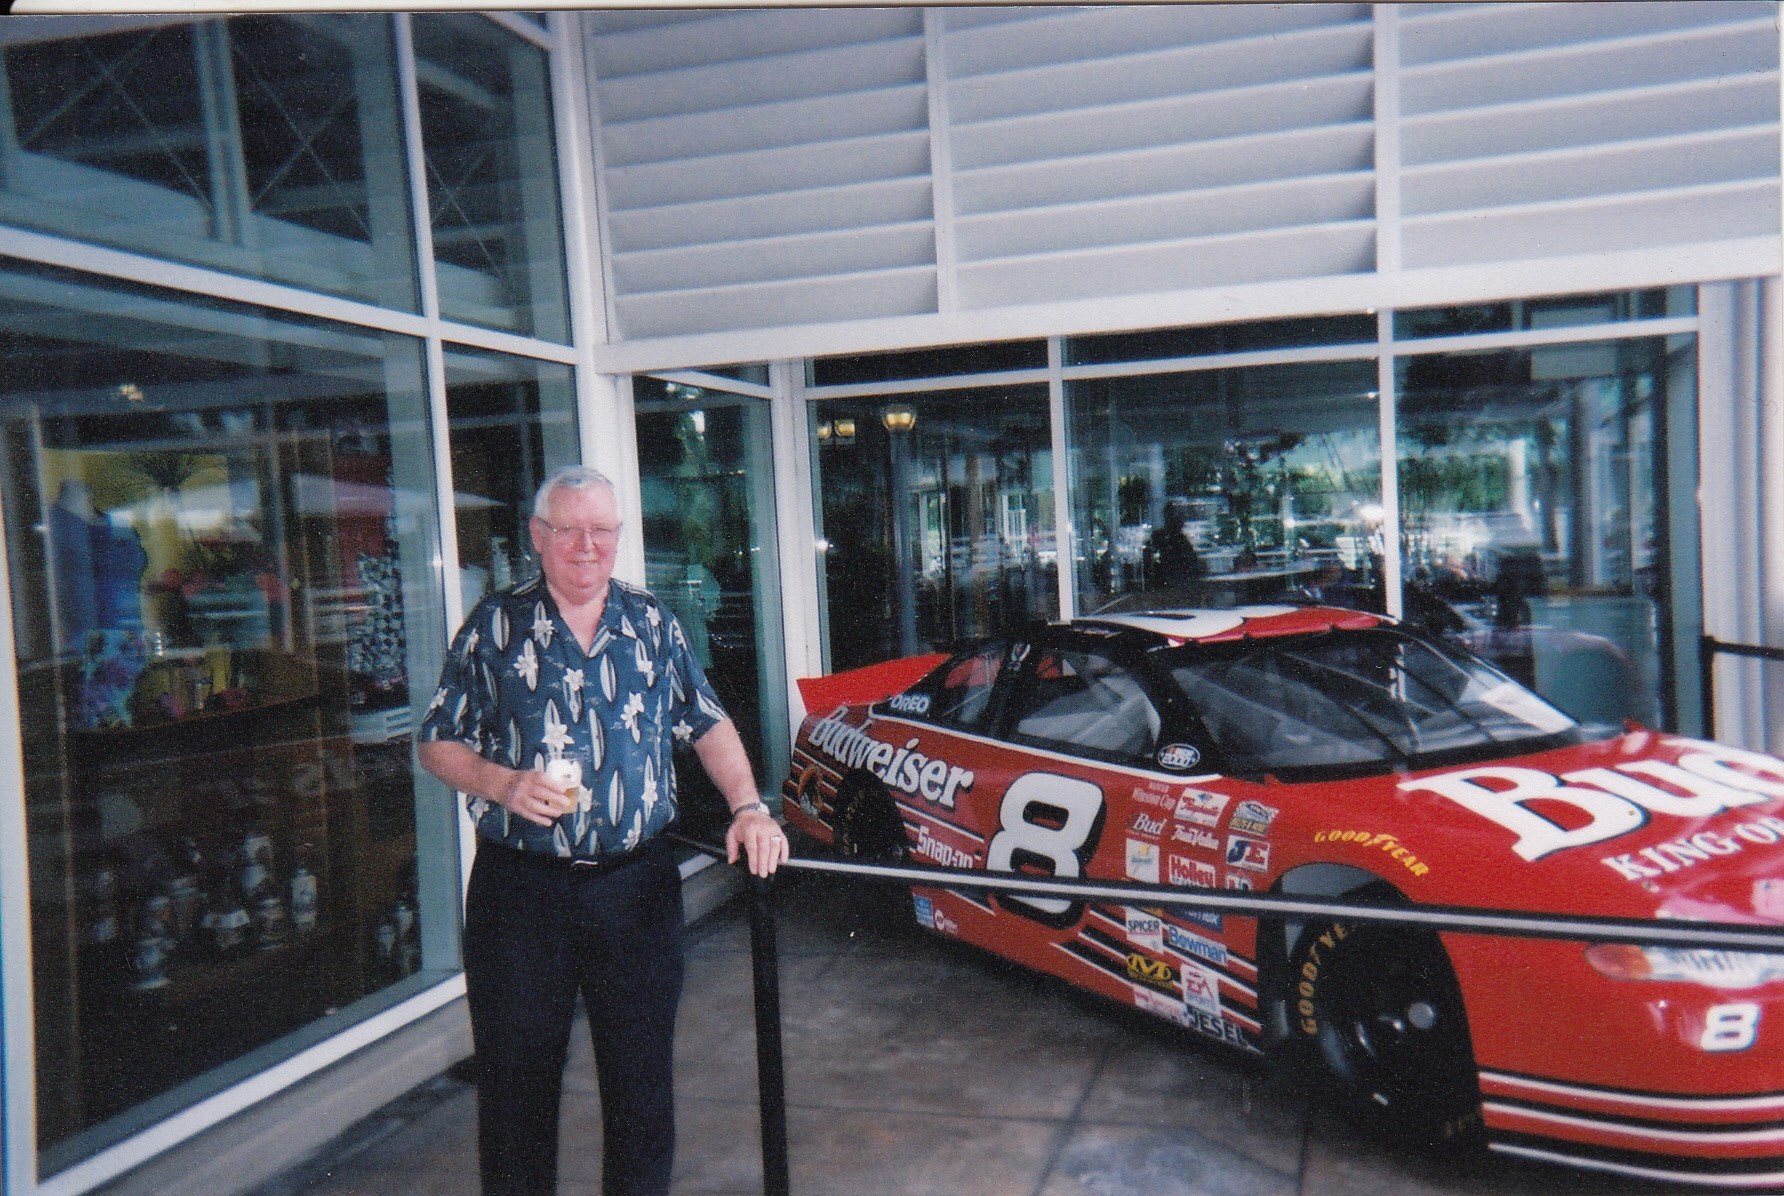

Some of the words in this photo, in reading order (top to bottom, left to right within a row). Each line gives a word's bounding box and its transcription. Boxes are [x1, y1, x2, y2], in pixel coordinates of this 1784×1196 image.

[890, 694, 930, 714] OREO
[807, 704, 974, 808] Budweiser
[986, 771, 1104, 914] 8
[1132, 811, 1168, 836] Bud
[1314, 829, 1430, 877] GOODYEAR
[1600, 830, 1743, 882] KING
[1127, 918, 1161, 933] SPICER
[1168, 924, 1228, 965] Bowman
[1700, 1002, 1761, 1052] 8
